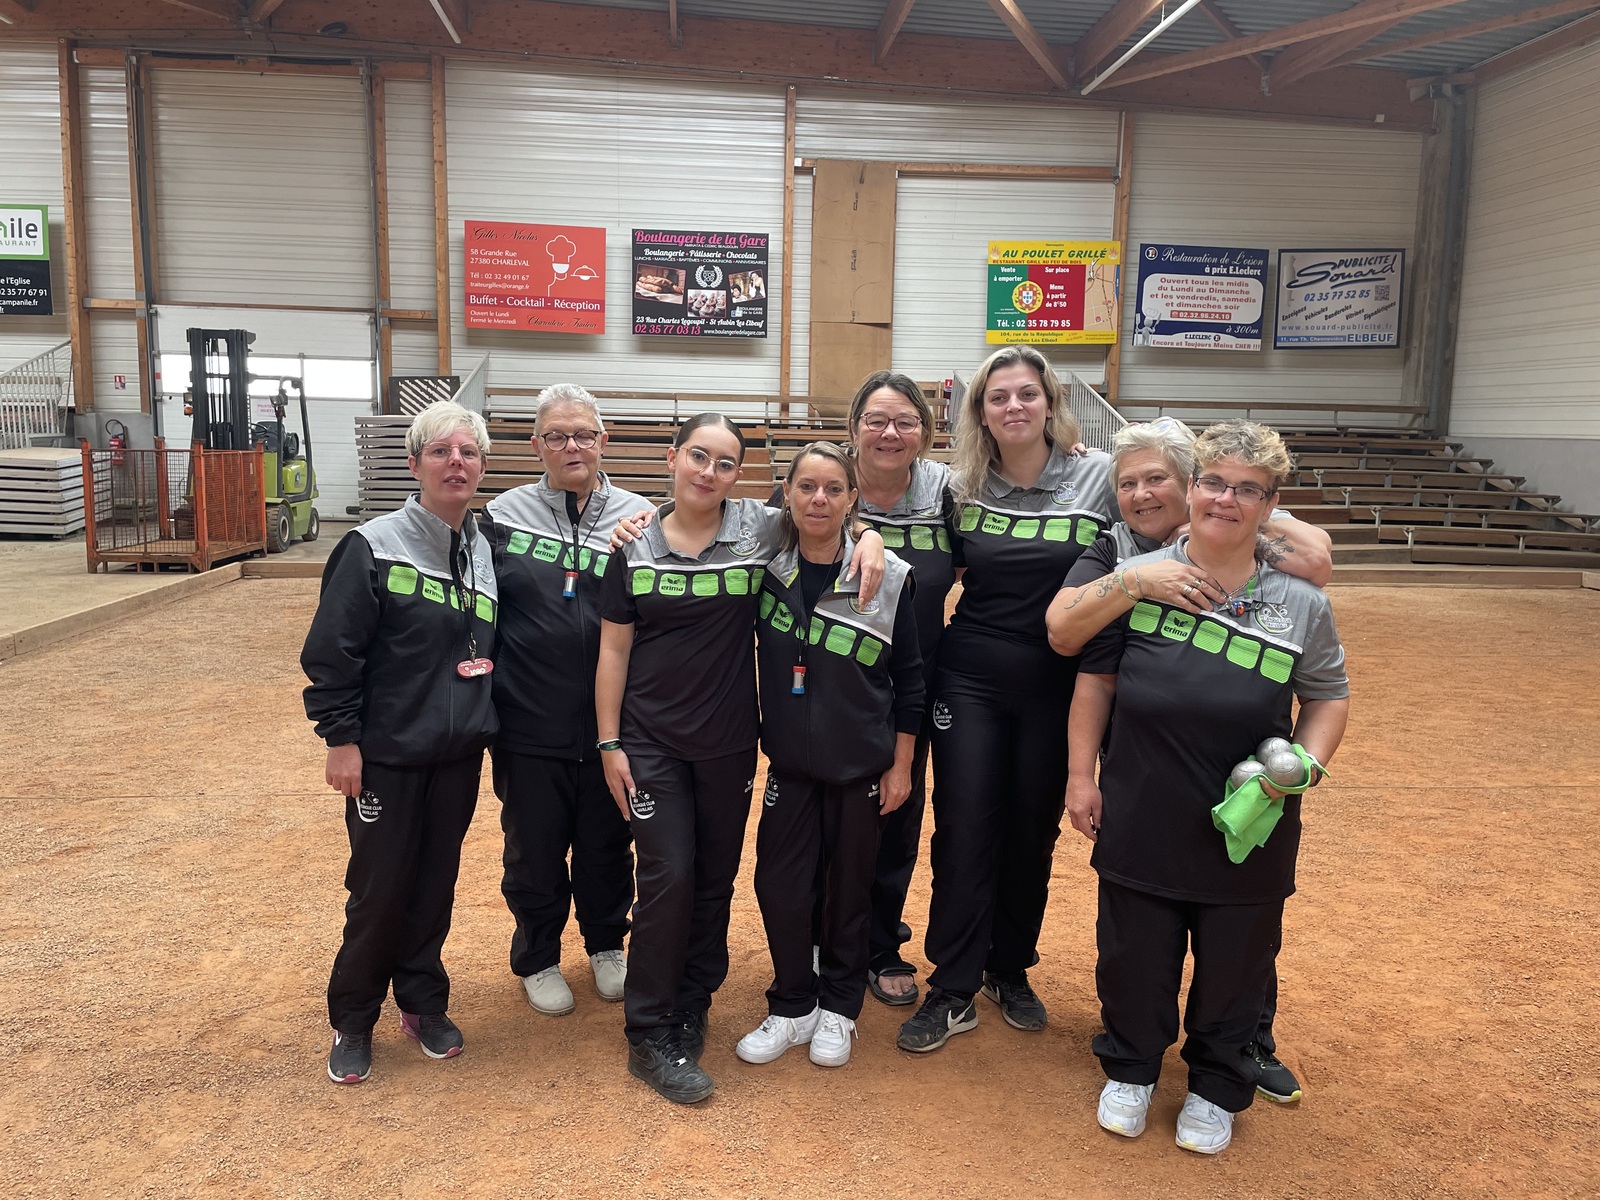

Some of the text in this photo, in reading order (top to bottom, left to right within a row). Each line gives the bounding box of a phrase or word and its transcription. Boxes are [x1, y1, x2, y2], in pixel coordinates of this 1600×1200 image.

[470, 227, 538, 240] Gilles Nicolas
[634, 230, 766, 248] Boulangerie de la Gare
[644, 248, 757, 260] Boulangerie Pâtisserie Chocolats
[1002, 248, 1107, 258] AU POULET GRILLÉ
[1161, 247, 1263, 266] Restauration de L'oison
[492, 258, 530, 266] CHARLEVAL
[1337, 255, 1390, 269] PUBLICITE
[1212, 265, 1227, 275] prix
[1229, 266, 1261, 275] E.Leclerc
[1286, 254, 1397, 288] Souard
[7, 288, 16, 296] 35
[1209, 287, 1250, 295] Dimanche
[1304, 290, 1371, 302] 02 35 77 52 85
[470, 295, 600, 312] Buffet Cocktail Réception
[1176, 294, 1219, 302] vendredis,
[1176, 301, 1222, 309] dimanches
[1179, 312, 1230, 320] 02.32.96.24.10
[1282, 306, 1306, 321] Enseignes
[1304, 306, 1328, 320] Véhicules
[1324, 304, 1352, 320] Banderoles
[1346, 308, 1364, 320] Vitrines
[658, 316, 680, 324] Charles
[717, 318, 735, 326] Aubin
[736, 319, 745, 327] Les
[746, 319, 764, 328] Elbeuf
[634, 325, 700, 335] 02 35 77 03 13
[704, 328, 766, 336] www.boulangeriedelagare.com
[1226, 325, 1259, 334] à 300m
[1347, 333, 1394, 342] ELBEUF
[983, 523, 1005, 532] erima
[535, 550, 556, 559] erima
[1163, 625, 1188, 638] erima
